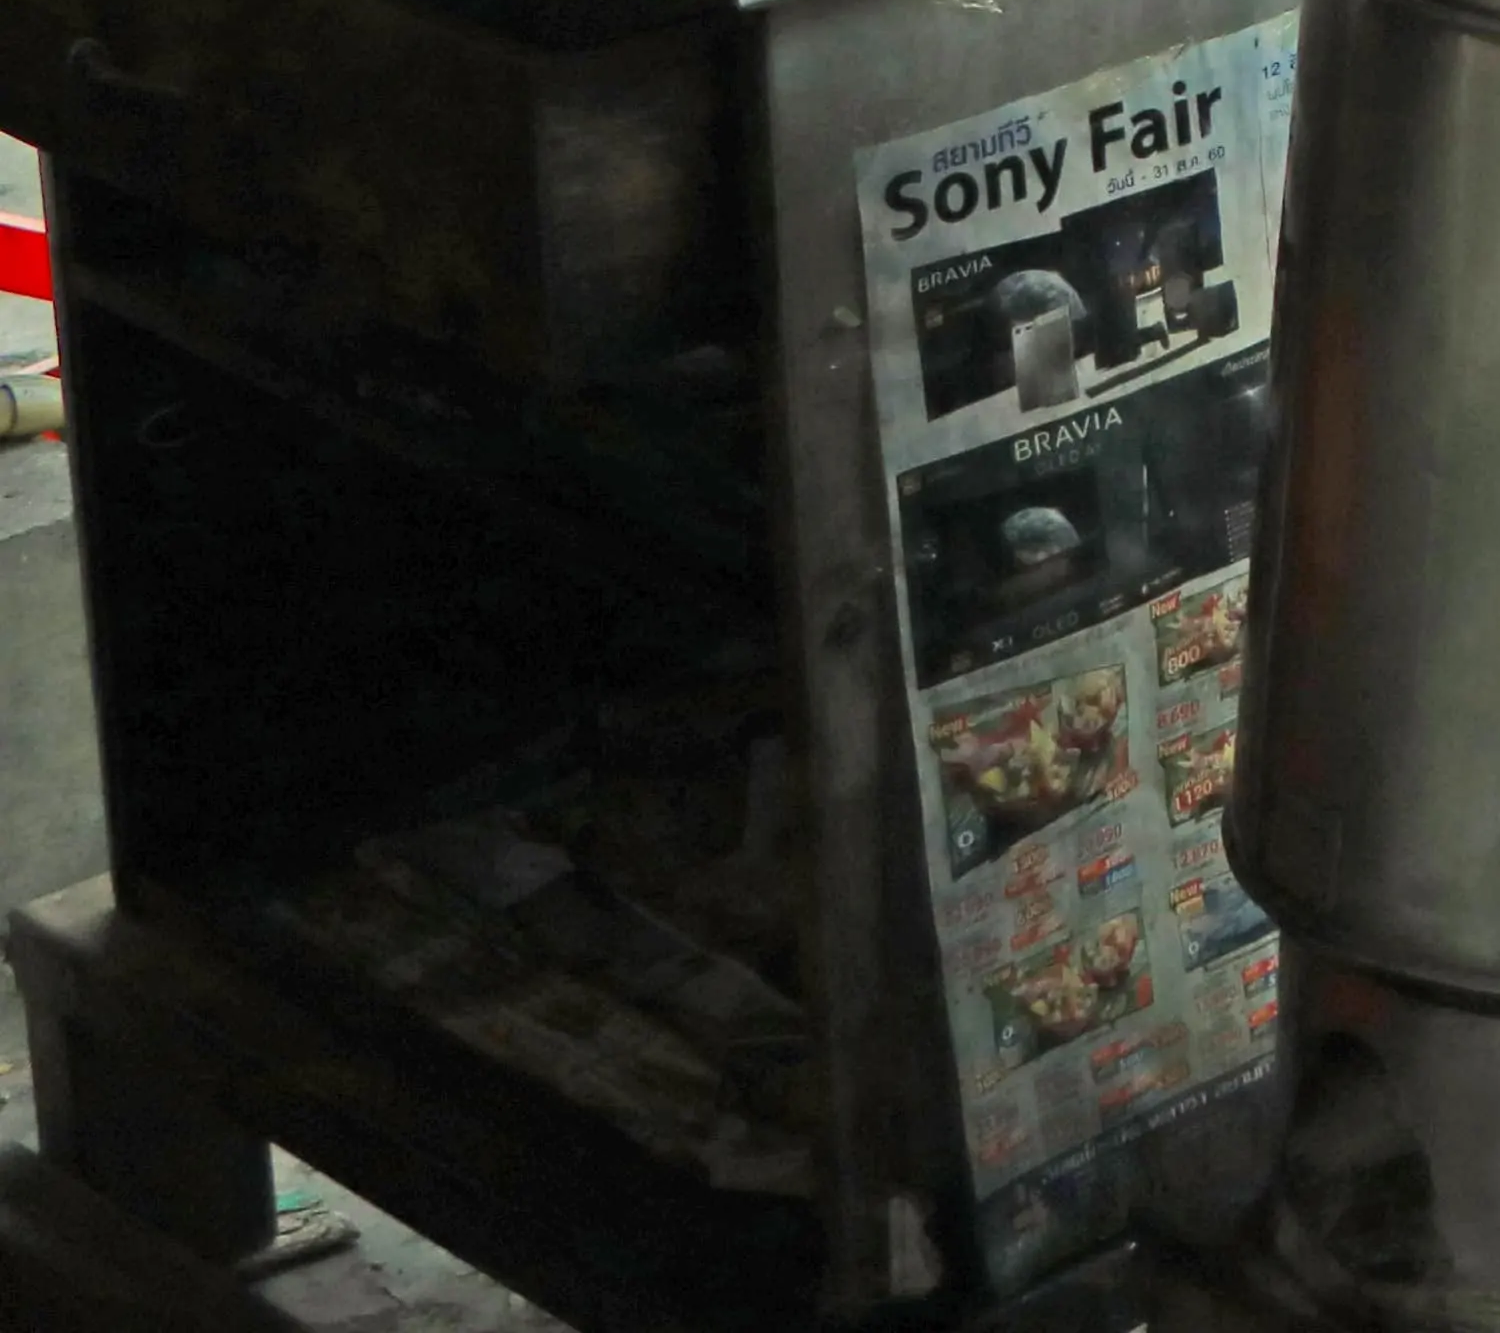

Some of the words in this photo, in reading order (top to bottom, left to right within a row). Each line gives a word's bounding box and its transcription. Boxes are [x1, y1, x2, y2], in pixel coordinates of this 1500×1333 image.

[1262, 61, 1281, 80] 12
[884, 138, 1068, 242] Sony
[1089, 80, 1223, 173] Fair
[917, 254, 994, 294] BRAVIA
[1013, 406, 1124, 462] BRAVIA
